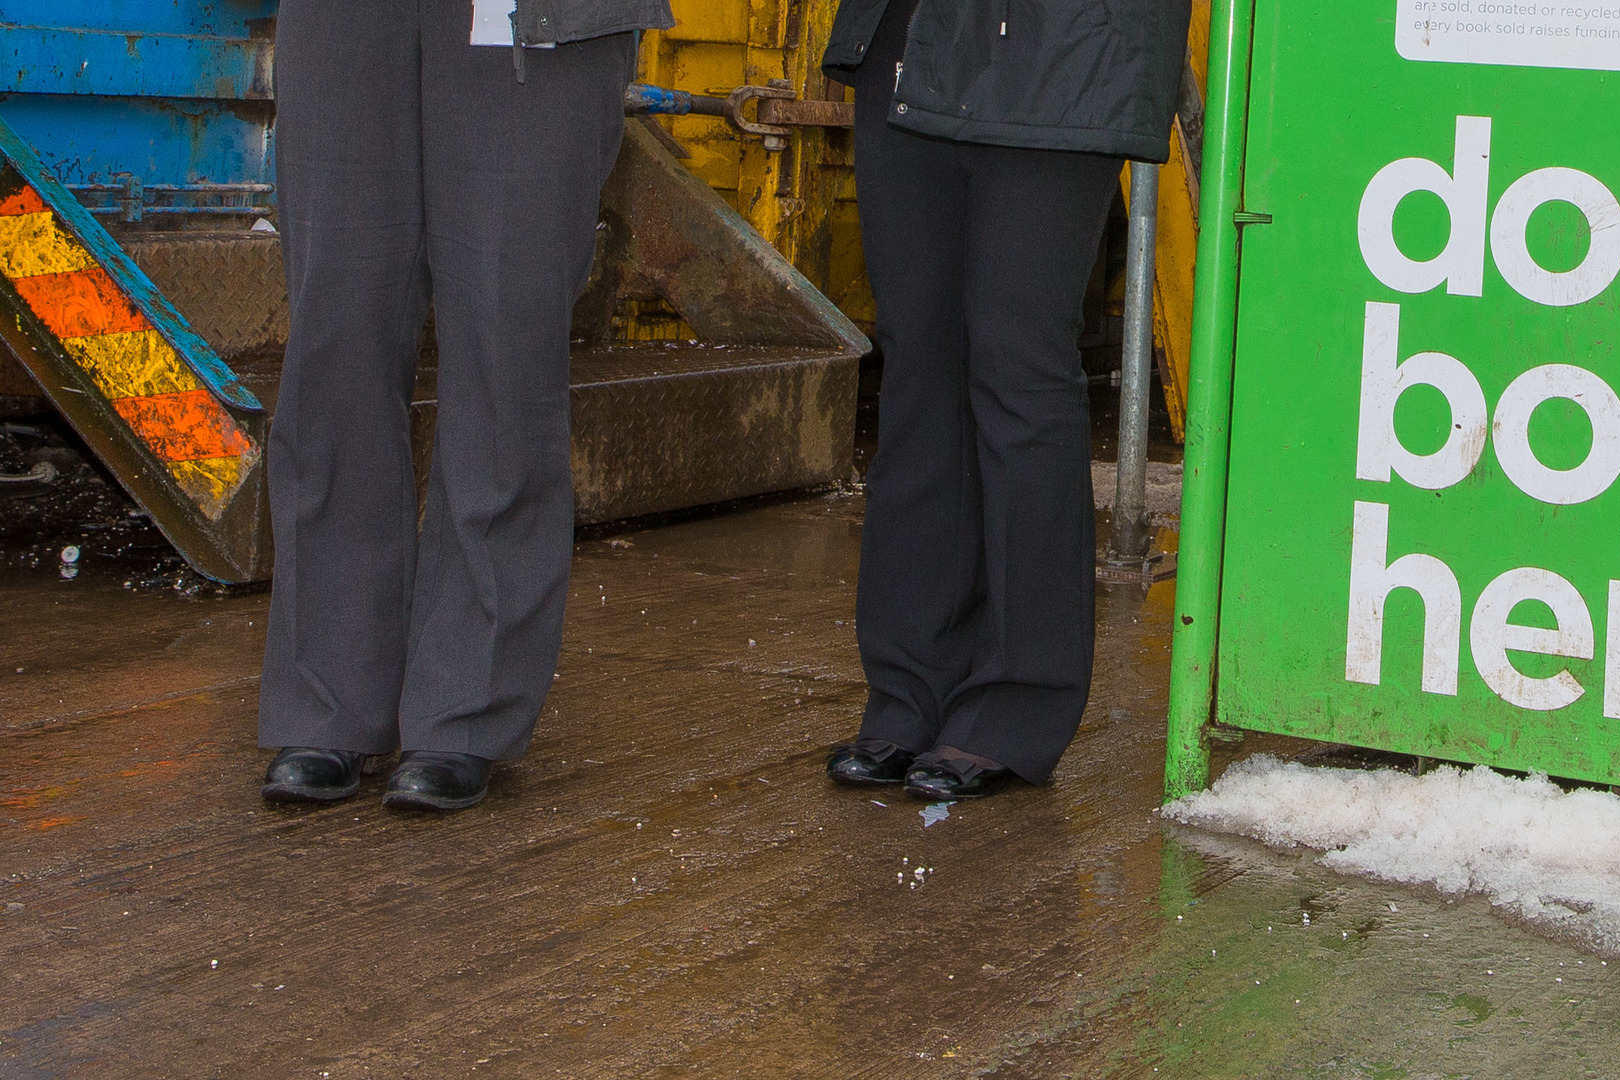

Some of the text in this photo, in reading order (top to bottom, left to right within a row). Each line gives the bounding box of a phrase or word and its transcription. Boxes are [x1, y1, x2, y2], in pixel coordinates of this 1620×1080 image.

[1414, 0, 1437, 12] are
[1440, 0, 1473, 14] sold,
[1477, 2, 1537, 15] donated
[1541, 6, 1556, 16] or
[1413, 20, 1451, 34] every
[1456, 20, 1492, 33] book
[1496, 22, 1526, 35] sold
[1530, 24, 1570, 37] raises
